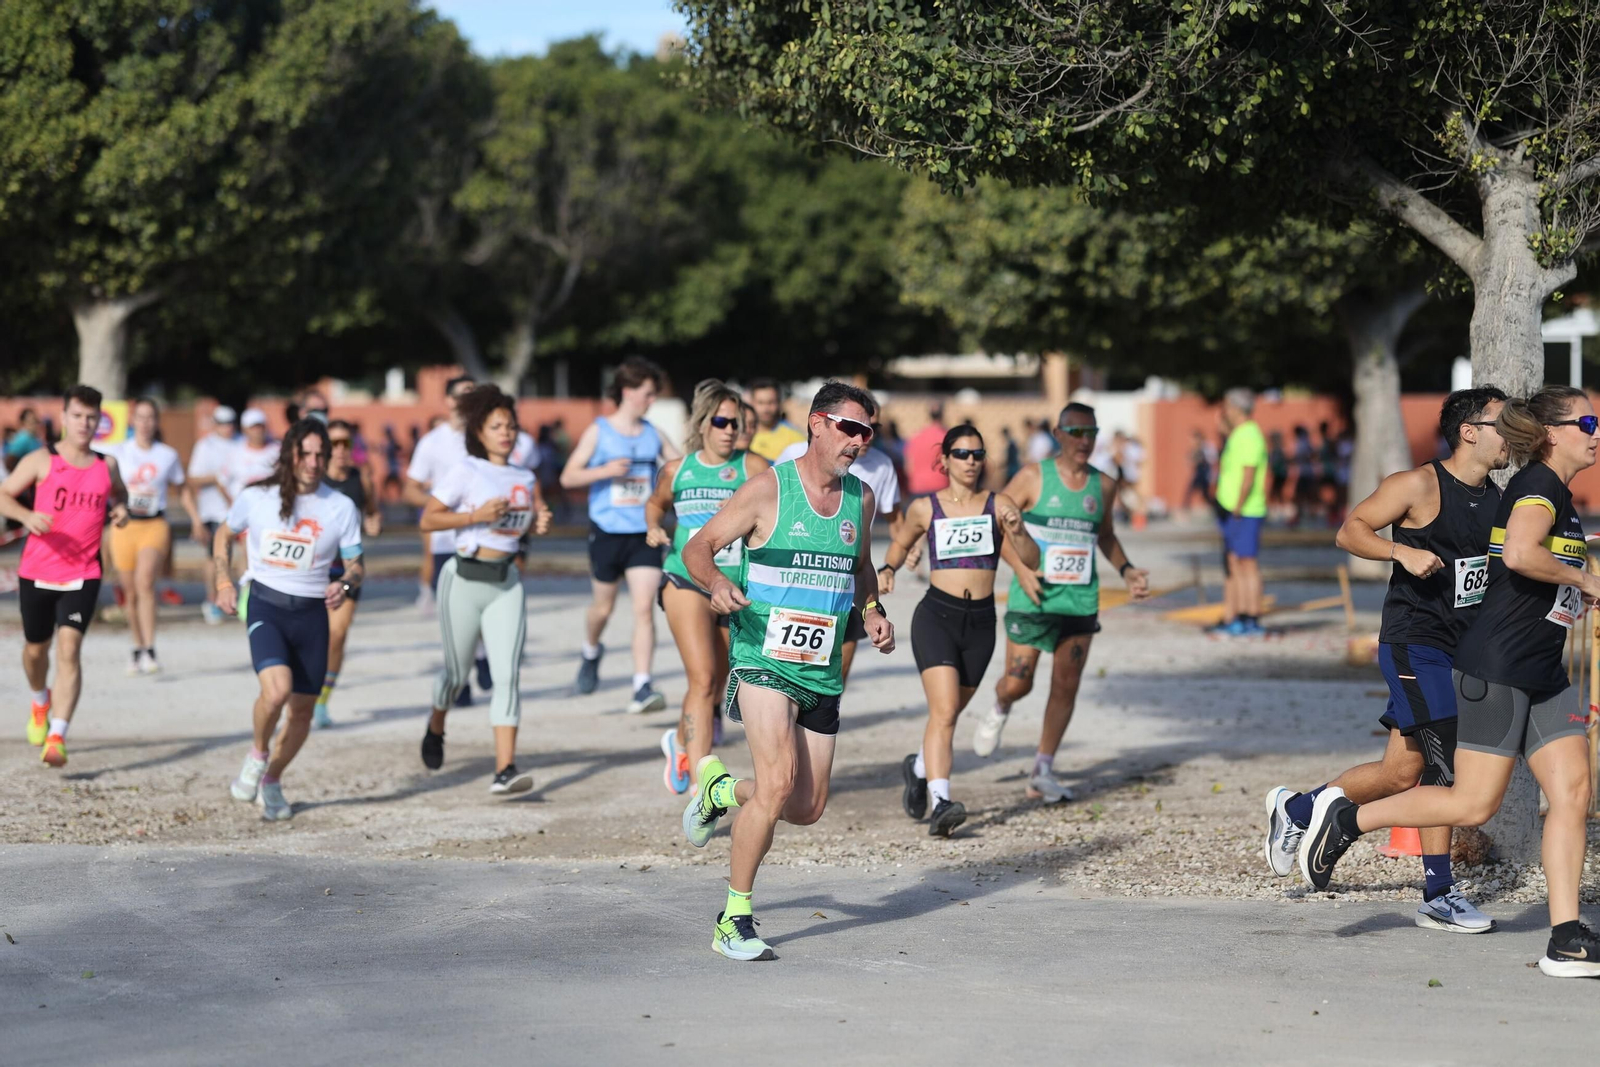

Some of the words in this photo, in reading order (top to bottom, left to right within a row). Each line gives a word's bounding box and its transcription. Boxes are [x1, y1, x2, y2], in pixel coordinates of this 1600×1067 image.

[680, 487, 734, 500] ATLETISMO
[499, 511, 526, 528] 211
[1046, 517, 1094, 531] ATLETISMO
[946, 526, 983, 545] 755
[269, 541, 305, 560] 210
[792, 552, 853, 571] ATLETISMO
[1053, 556, 1086, 573] 328
[1560, 586, 1580, 613] 296
[781, 623, 826, 650] 156
